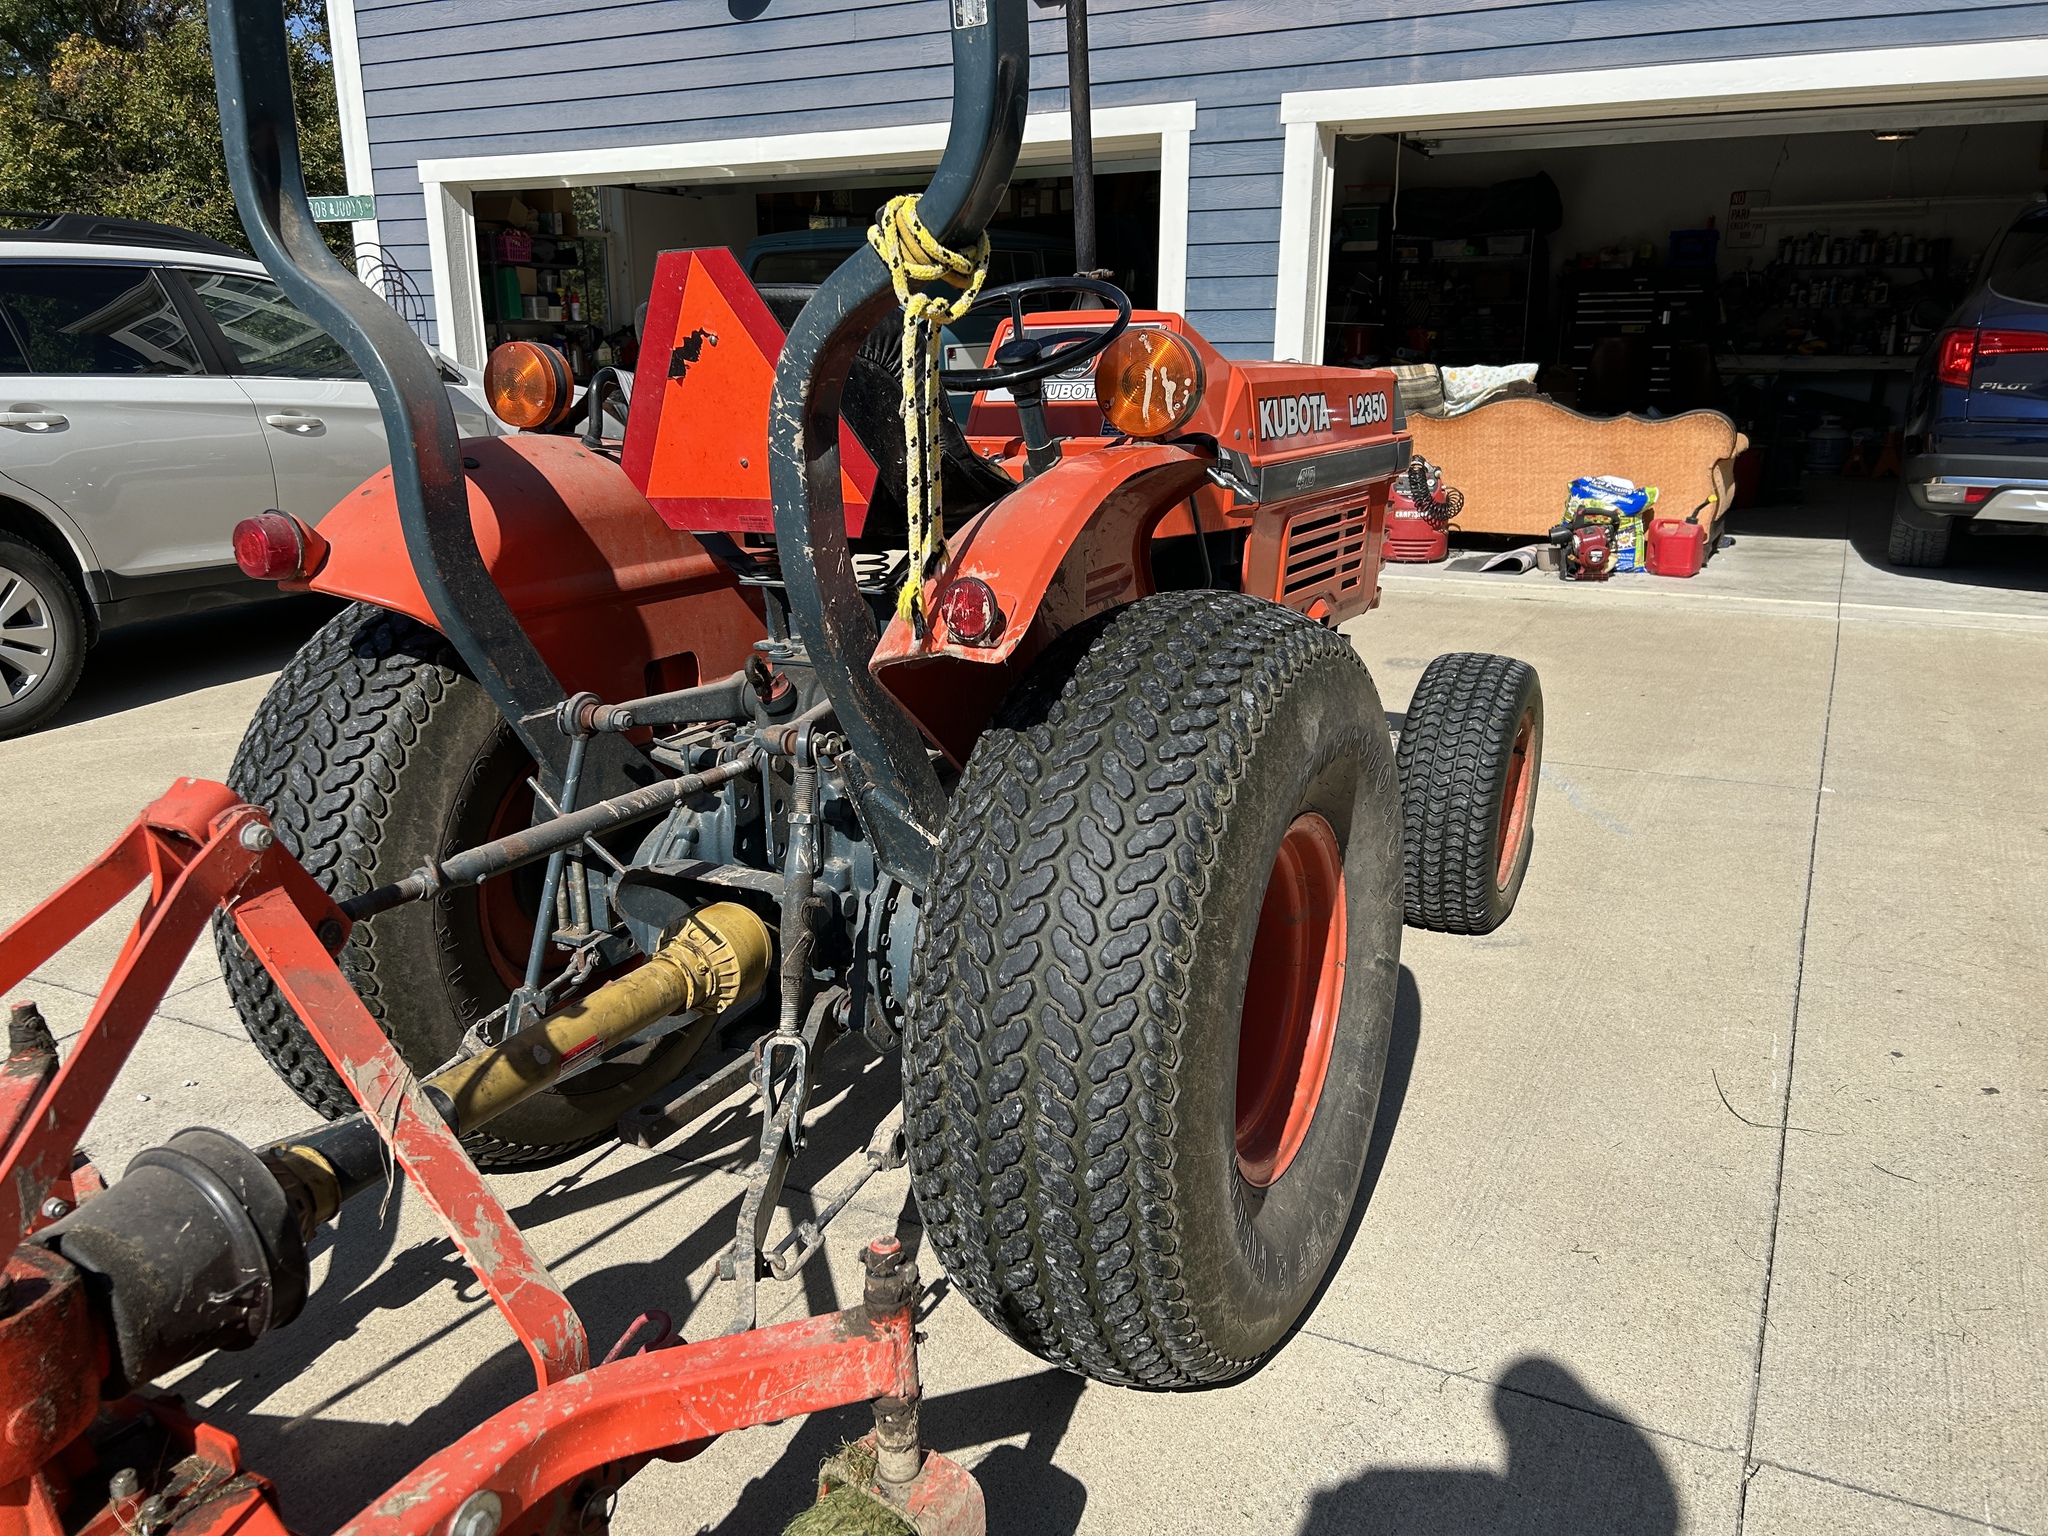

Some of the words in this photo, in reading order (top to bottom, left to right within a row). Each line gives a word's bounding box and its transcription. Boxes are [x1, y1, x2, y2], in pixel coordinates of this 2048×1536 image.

[1732, 194, 1744, 204] NO
[309, 201, 327, 218] BOB
[1980, 382, 2034, 391] PILOT
[1259, 393, 1331, 441] KUBOTA
[1348, 391, 1388, 428] L2350
